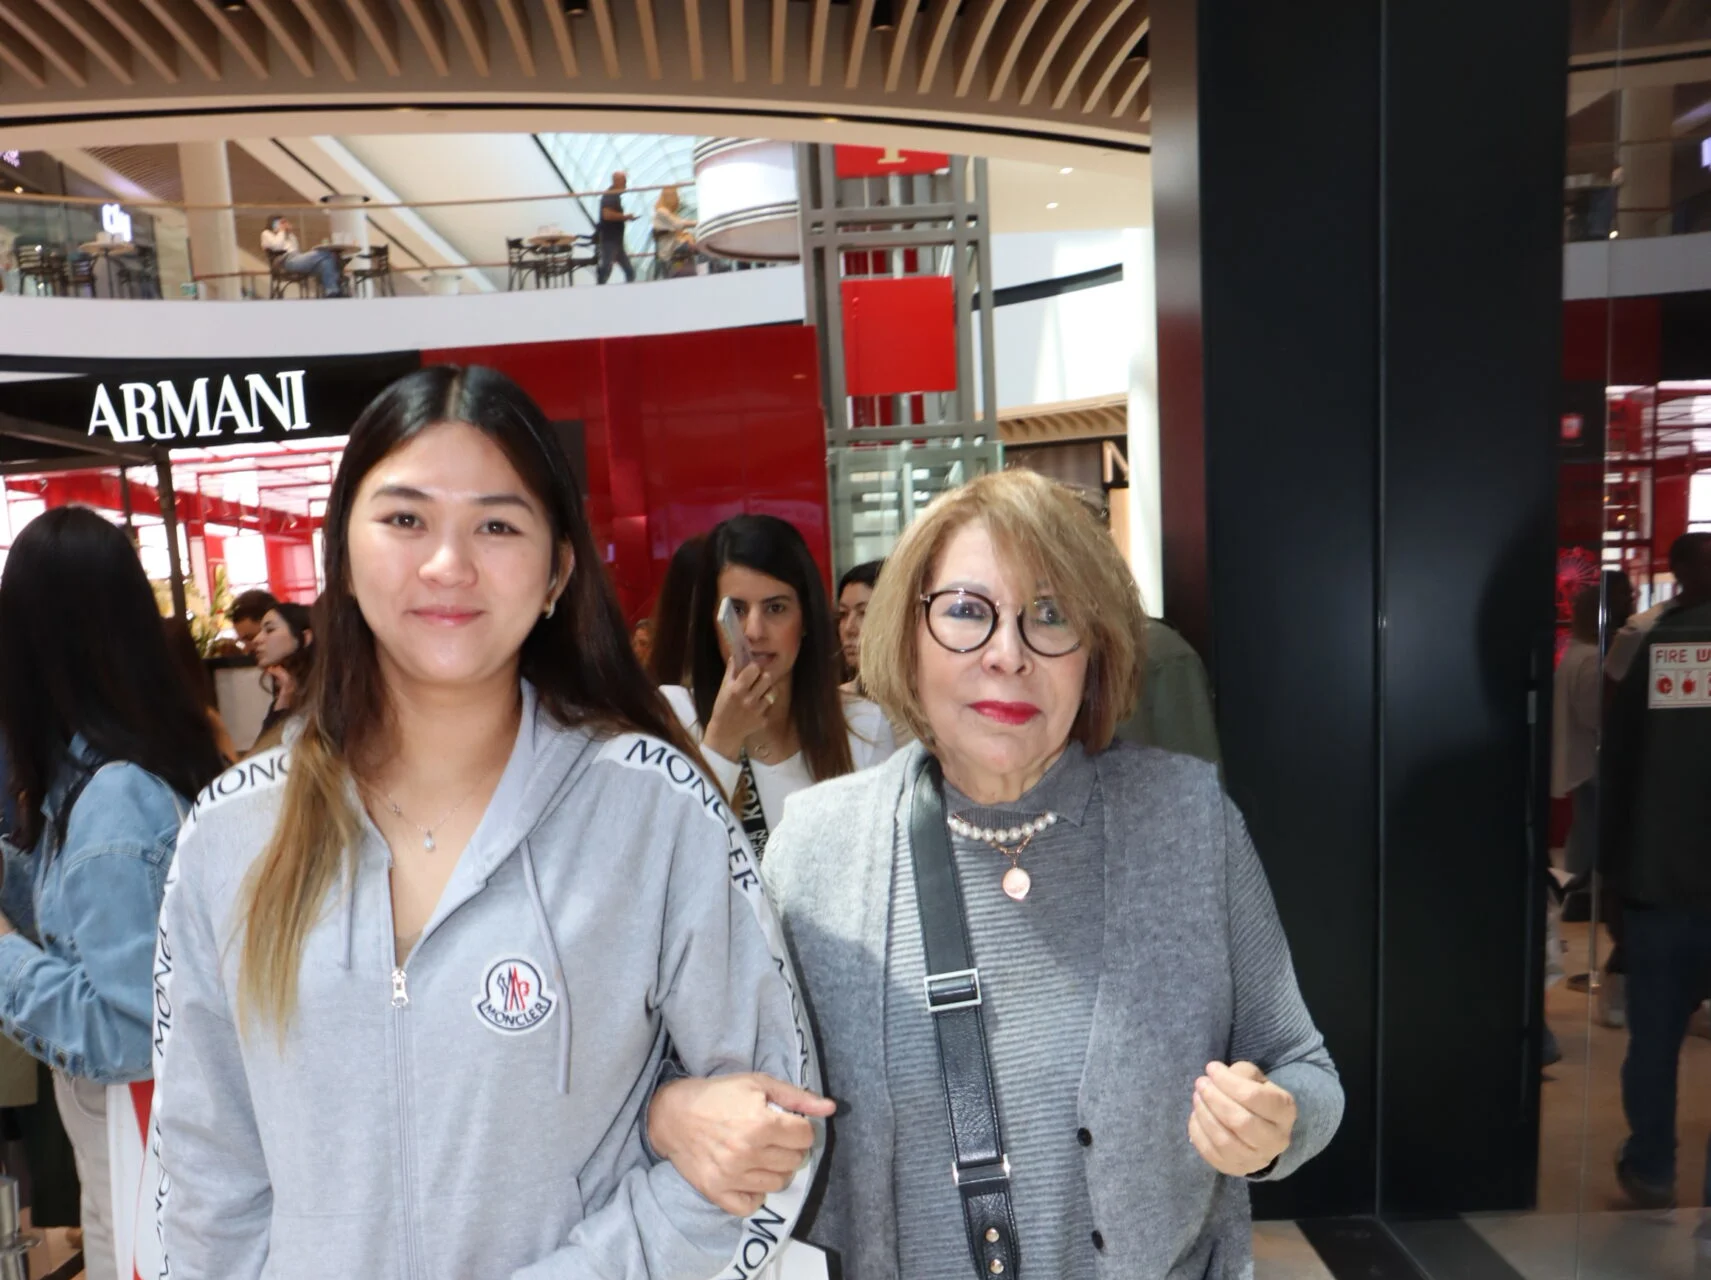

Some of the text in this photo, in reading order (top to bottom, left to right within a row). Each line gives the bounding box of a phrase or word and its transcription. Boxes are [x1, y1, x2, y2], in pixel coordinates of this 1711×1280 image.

[87, 370, 311, 443] ARMANI
[1655, 649, 1688, 663] FIRE
[624, 738, 759, 893] MONCLER
[485, 1003, 546, 1026] MONCLER
